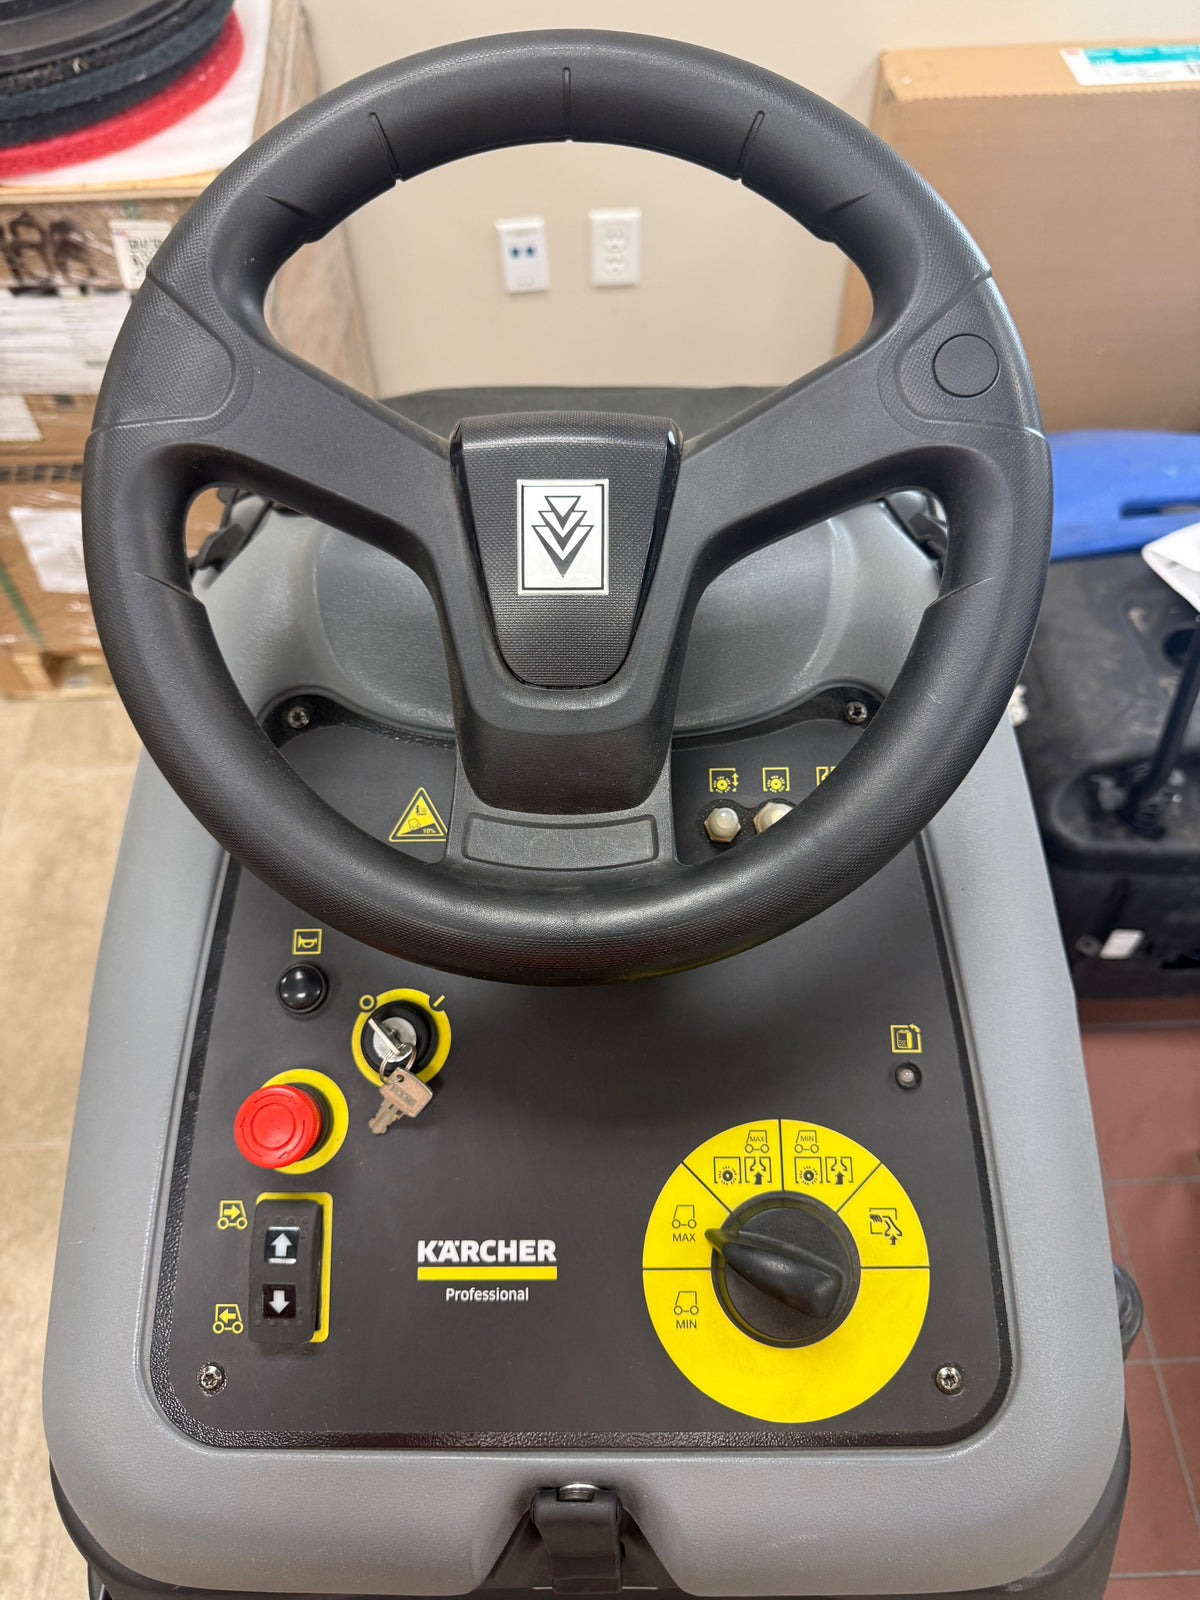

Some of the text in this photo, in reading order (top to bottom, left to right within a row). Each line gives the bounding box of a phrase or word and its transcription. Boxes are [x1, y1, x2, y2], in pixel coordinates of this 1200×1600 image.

[672, 1232, 696, 1243] MAX
[417, 1239, 557, 1263] KÄRCHER
[445, 1287, 529, 1302] Professional
[675, 1319, 697, 1330] MIN
